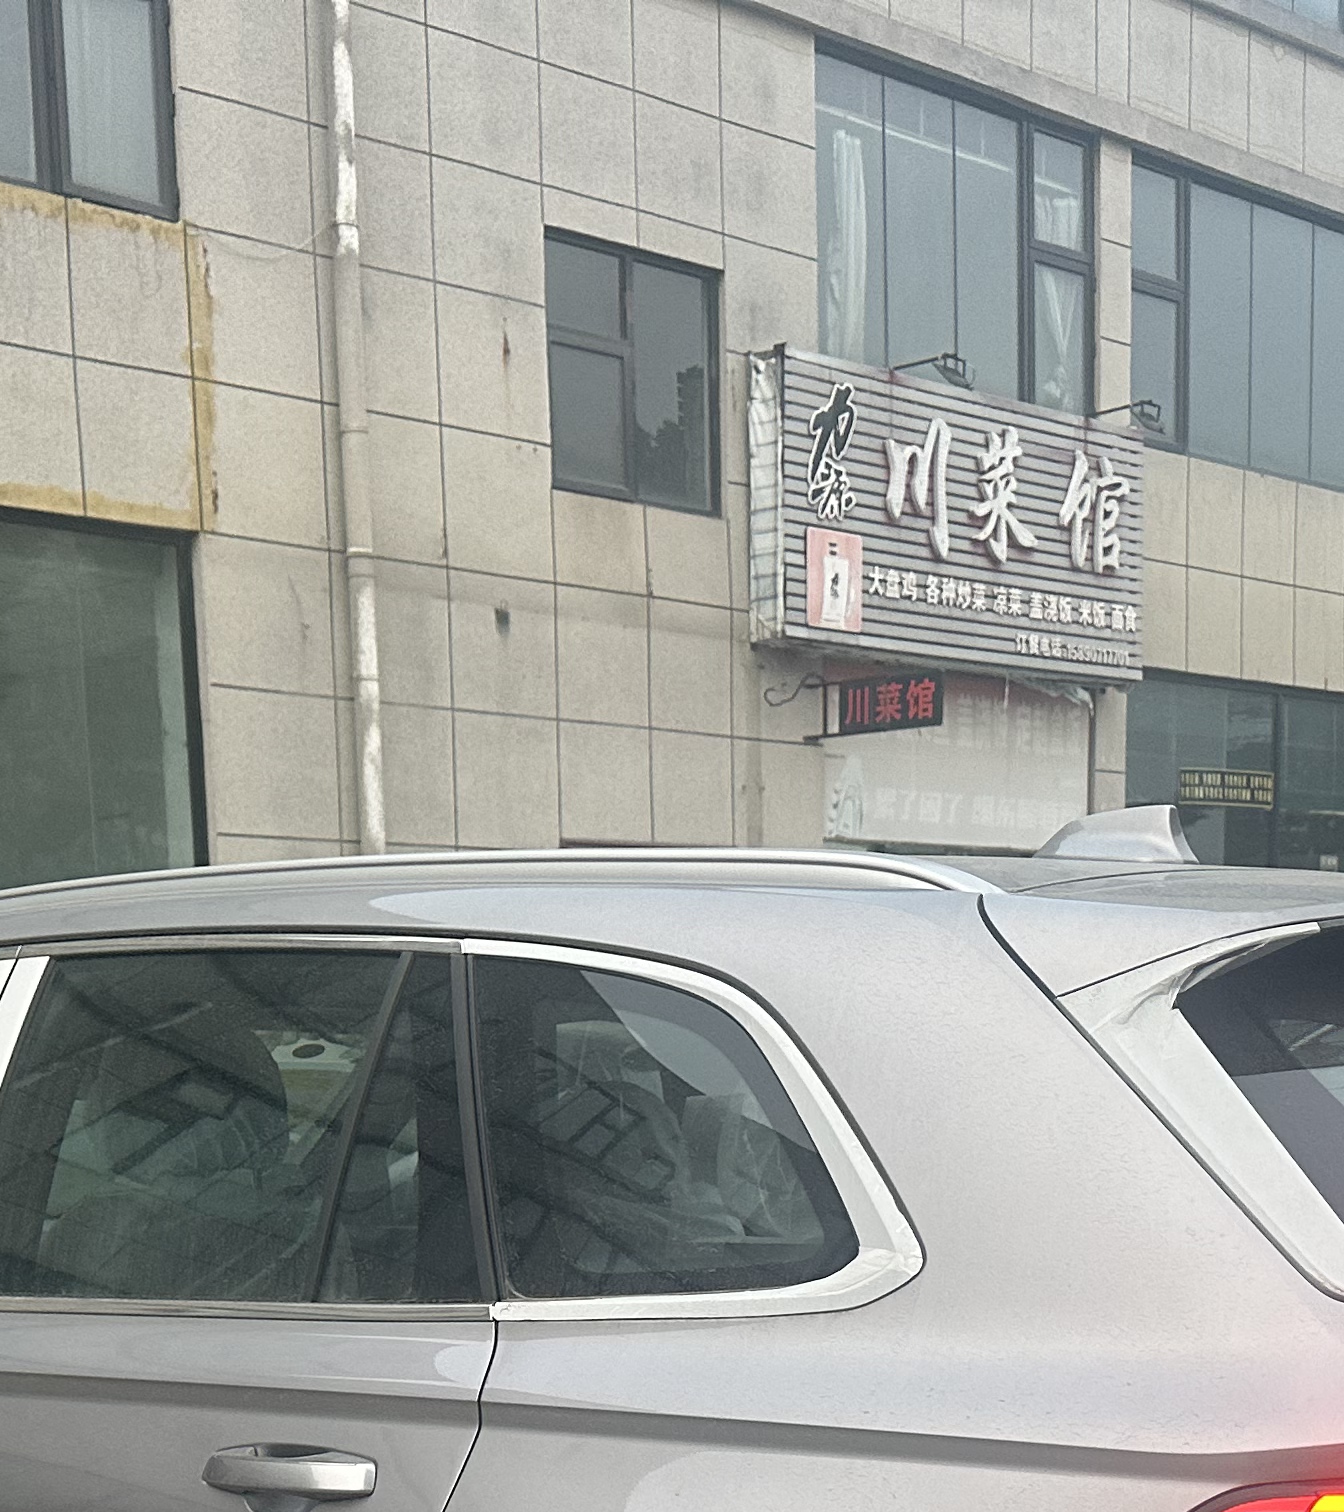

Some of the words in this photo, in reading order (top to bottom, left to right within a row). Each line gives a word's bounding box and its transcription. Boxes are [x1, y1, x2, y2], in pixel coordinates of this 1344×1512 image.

[884, 418, 1130, 575] 川菜馆
[868, 565, 917, 602] 大盘鸡
[925, 574, 987, 612] 各种炒菜
[1029, 591, 1073, 624] 盖浇饭
[1078, 599, 1106, 629] 米饭
[1110, 604, 1137, 633] 面食
[844, 678, 937, 726] 川菜馆
